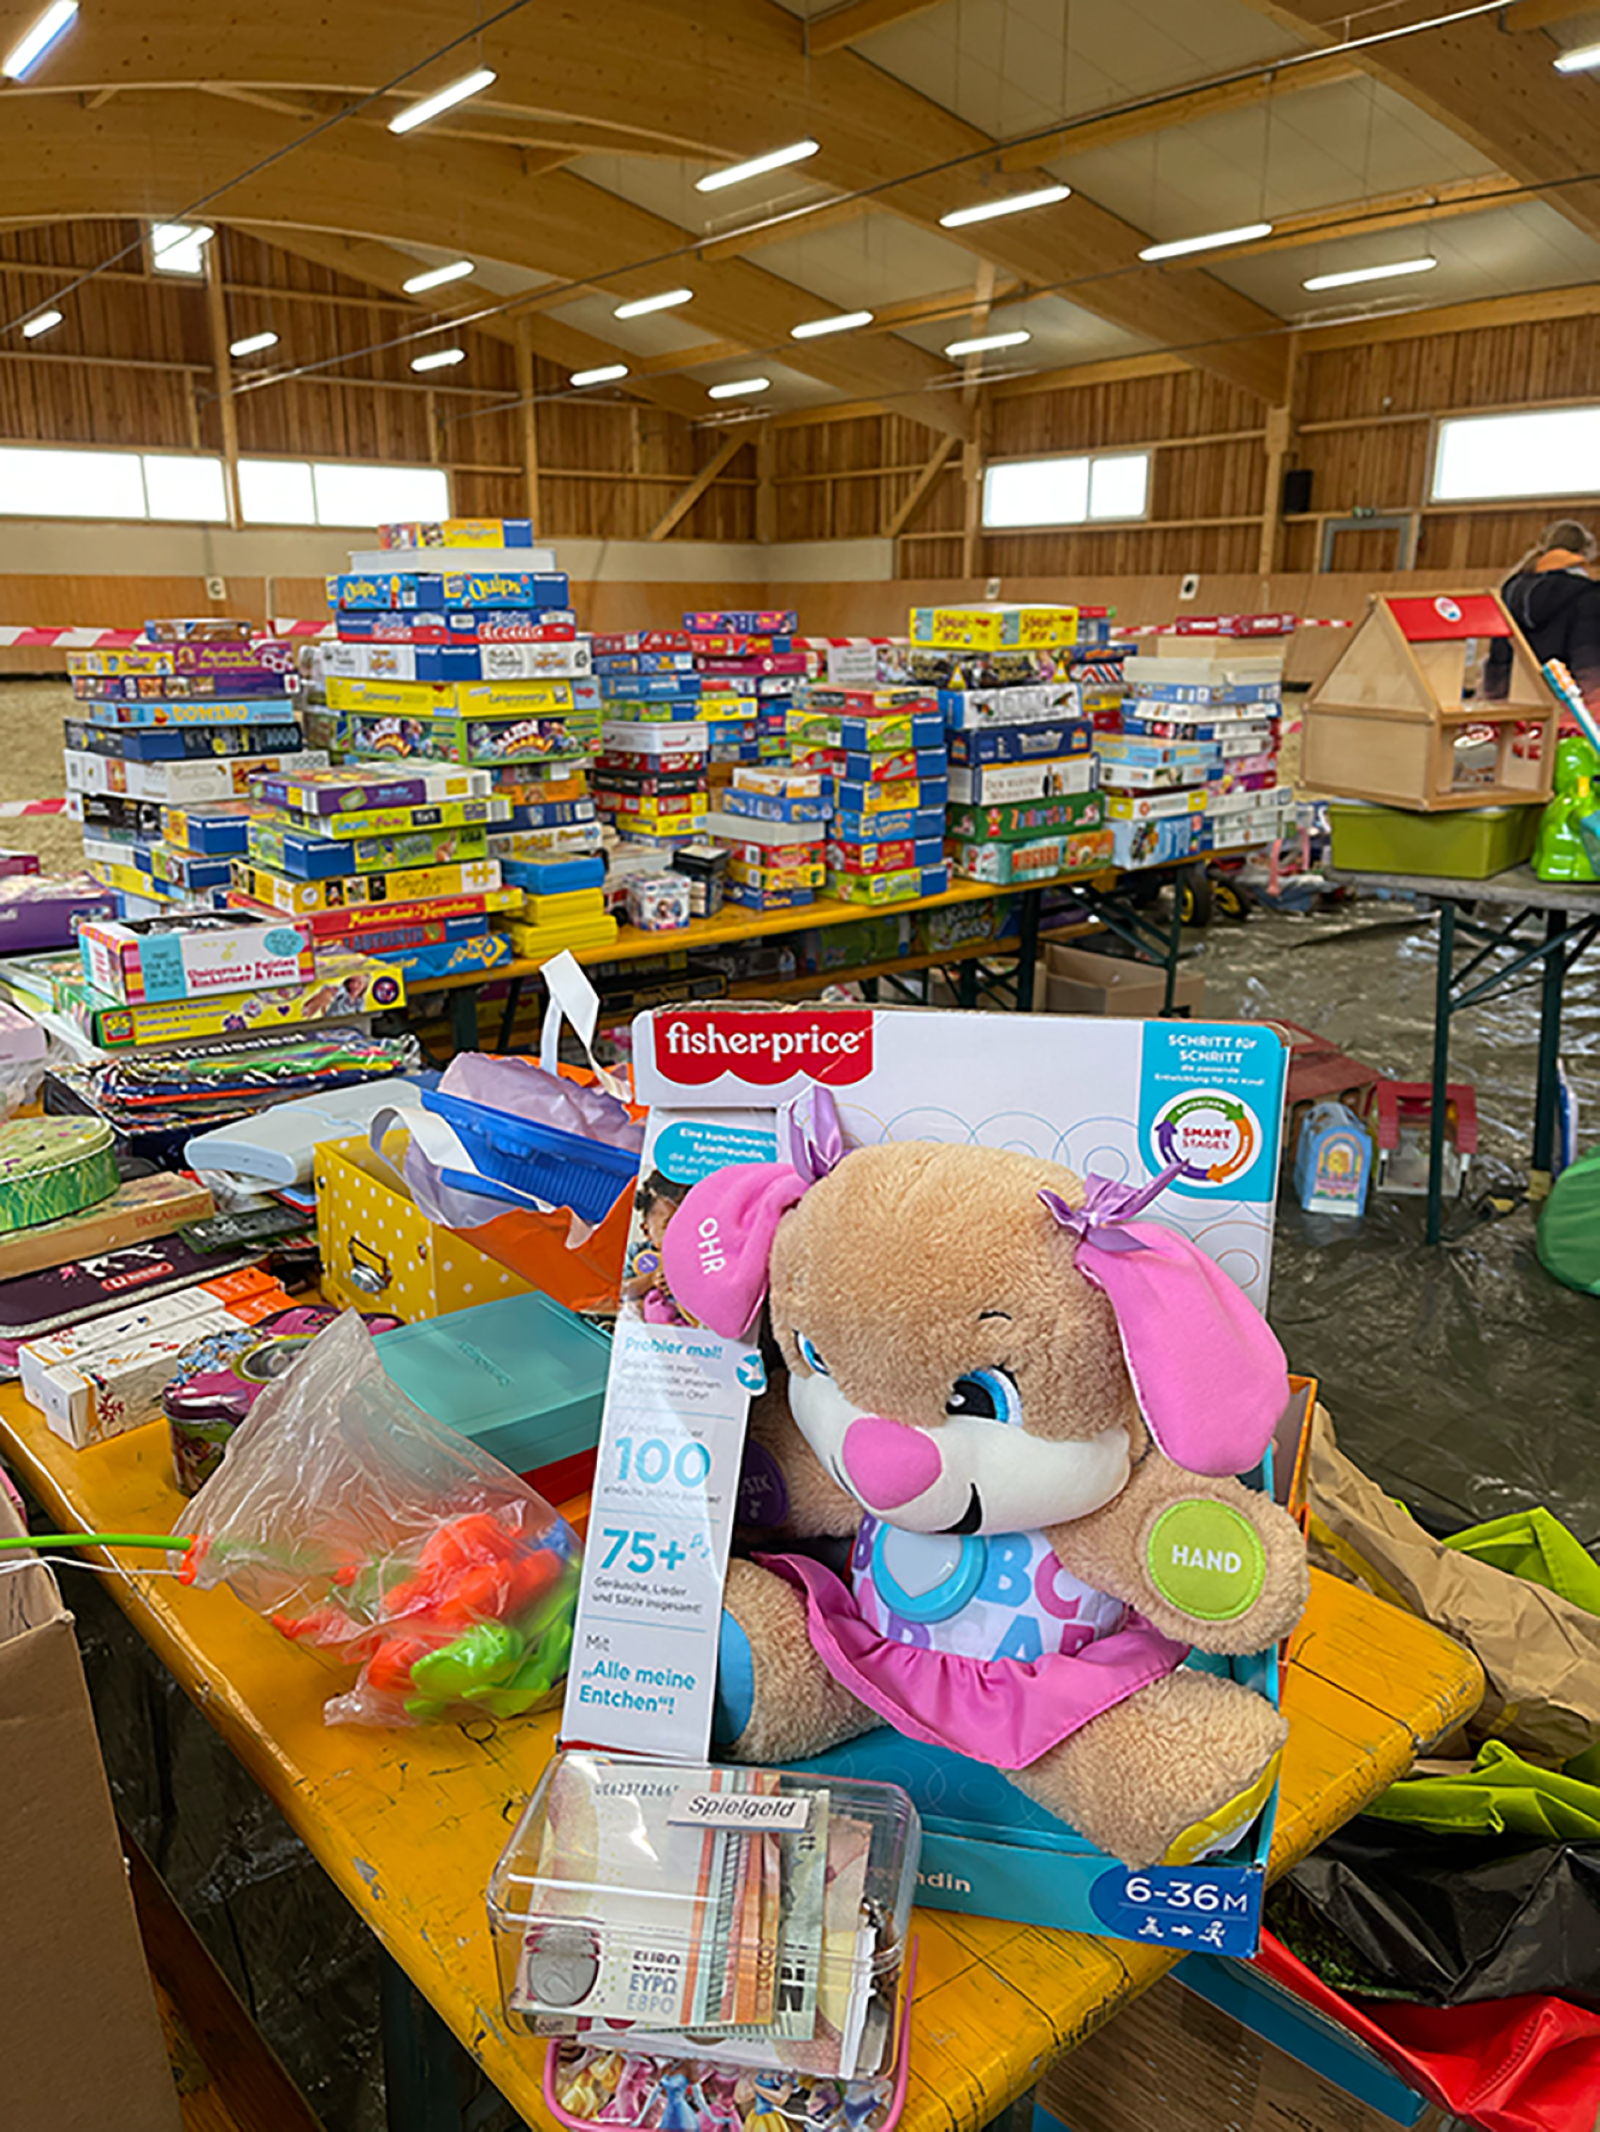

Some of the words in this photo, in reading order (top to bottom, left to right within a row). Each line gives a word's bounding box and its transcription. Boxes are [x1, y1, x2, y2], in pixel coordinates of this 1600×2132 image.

[344, 577, 377, 602] Quips
[469, 573, 522, 600] Quips
[172, 704, 249, 722] DOMINO
[265, 727, 299, 746] 1000
[187, 963, 242, 979] Unicorns
[254, 956, 296, 972] Fairies
[267, 966, 296, 979] Feen
[665, 1021, 862, 1063] fisher-price
[1168, 1033, 1233, 1048] SCHRITT
[1179, 1050, 1243, 1063] SCHRITT
[680, 1126, 704, 1139] Eine
[1182, 1126, 1232, 1140] SMART
[1182, 1138, 1231, 1151] STAGES
[698, 1217, 727, 1275] OHR
[625, 1336, 683, 1356] Probier
[685, 1343, 724, 1361] mal!
[614, 1436, 711, 1489] 100
[600, 1527, 686, 1574] 75+
[1171, 1544, 1242, 1574] HAND
[592, 1576, 651, 1595] Geräusche,
[652, 1583, 687, 1597] Lieder
[590, 1592, 613, 1604] und
[614, 1593, 644, 1608] Sätze
[585, 1634, 611, 1652] Mit
[635, 1667, 697, 1691] meine
[688, 1795, 797, 1821] Spielgeld
